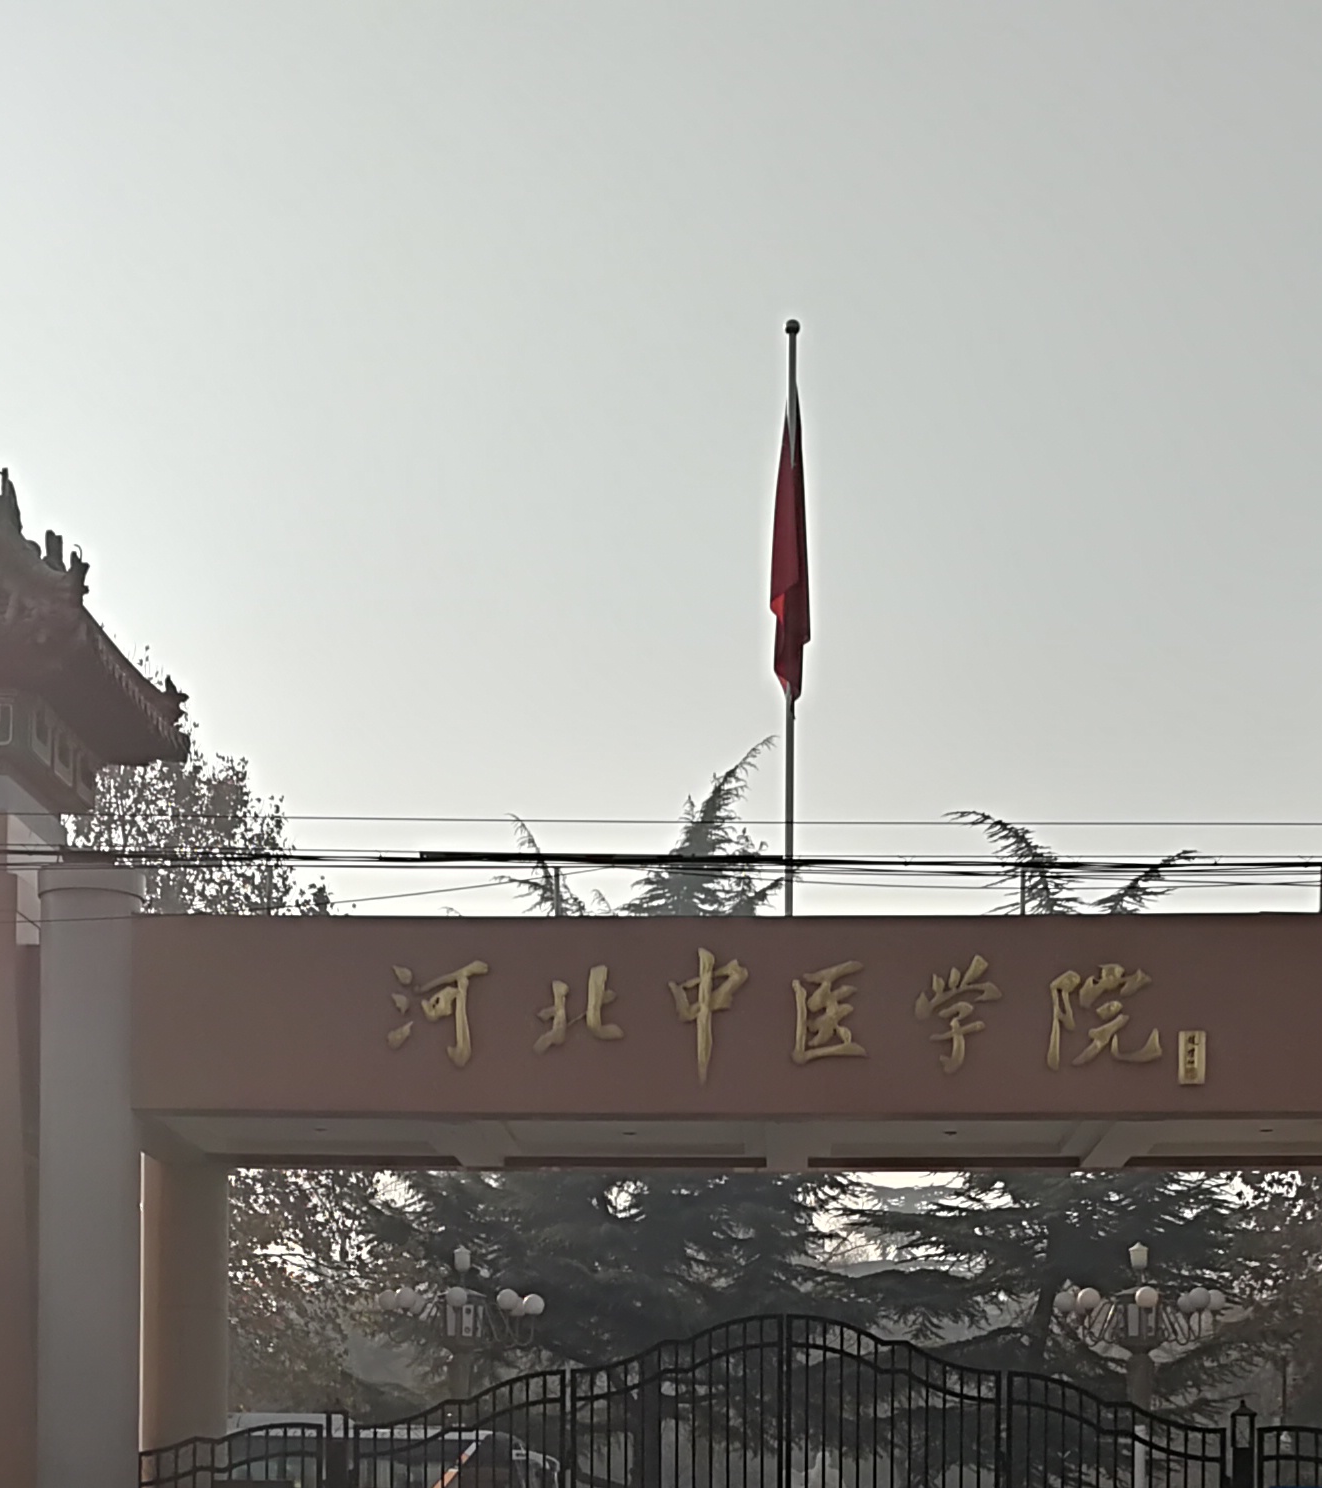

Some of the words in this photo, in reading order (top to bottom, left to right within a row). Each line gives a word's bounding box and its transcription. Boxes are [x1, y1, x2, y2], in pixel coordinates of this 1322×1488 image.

[385, 947, 1163, 1085] 河北中医学院
